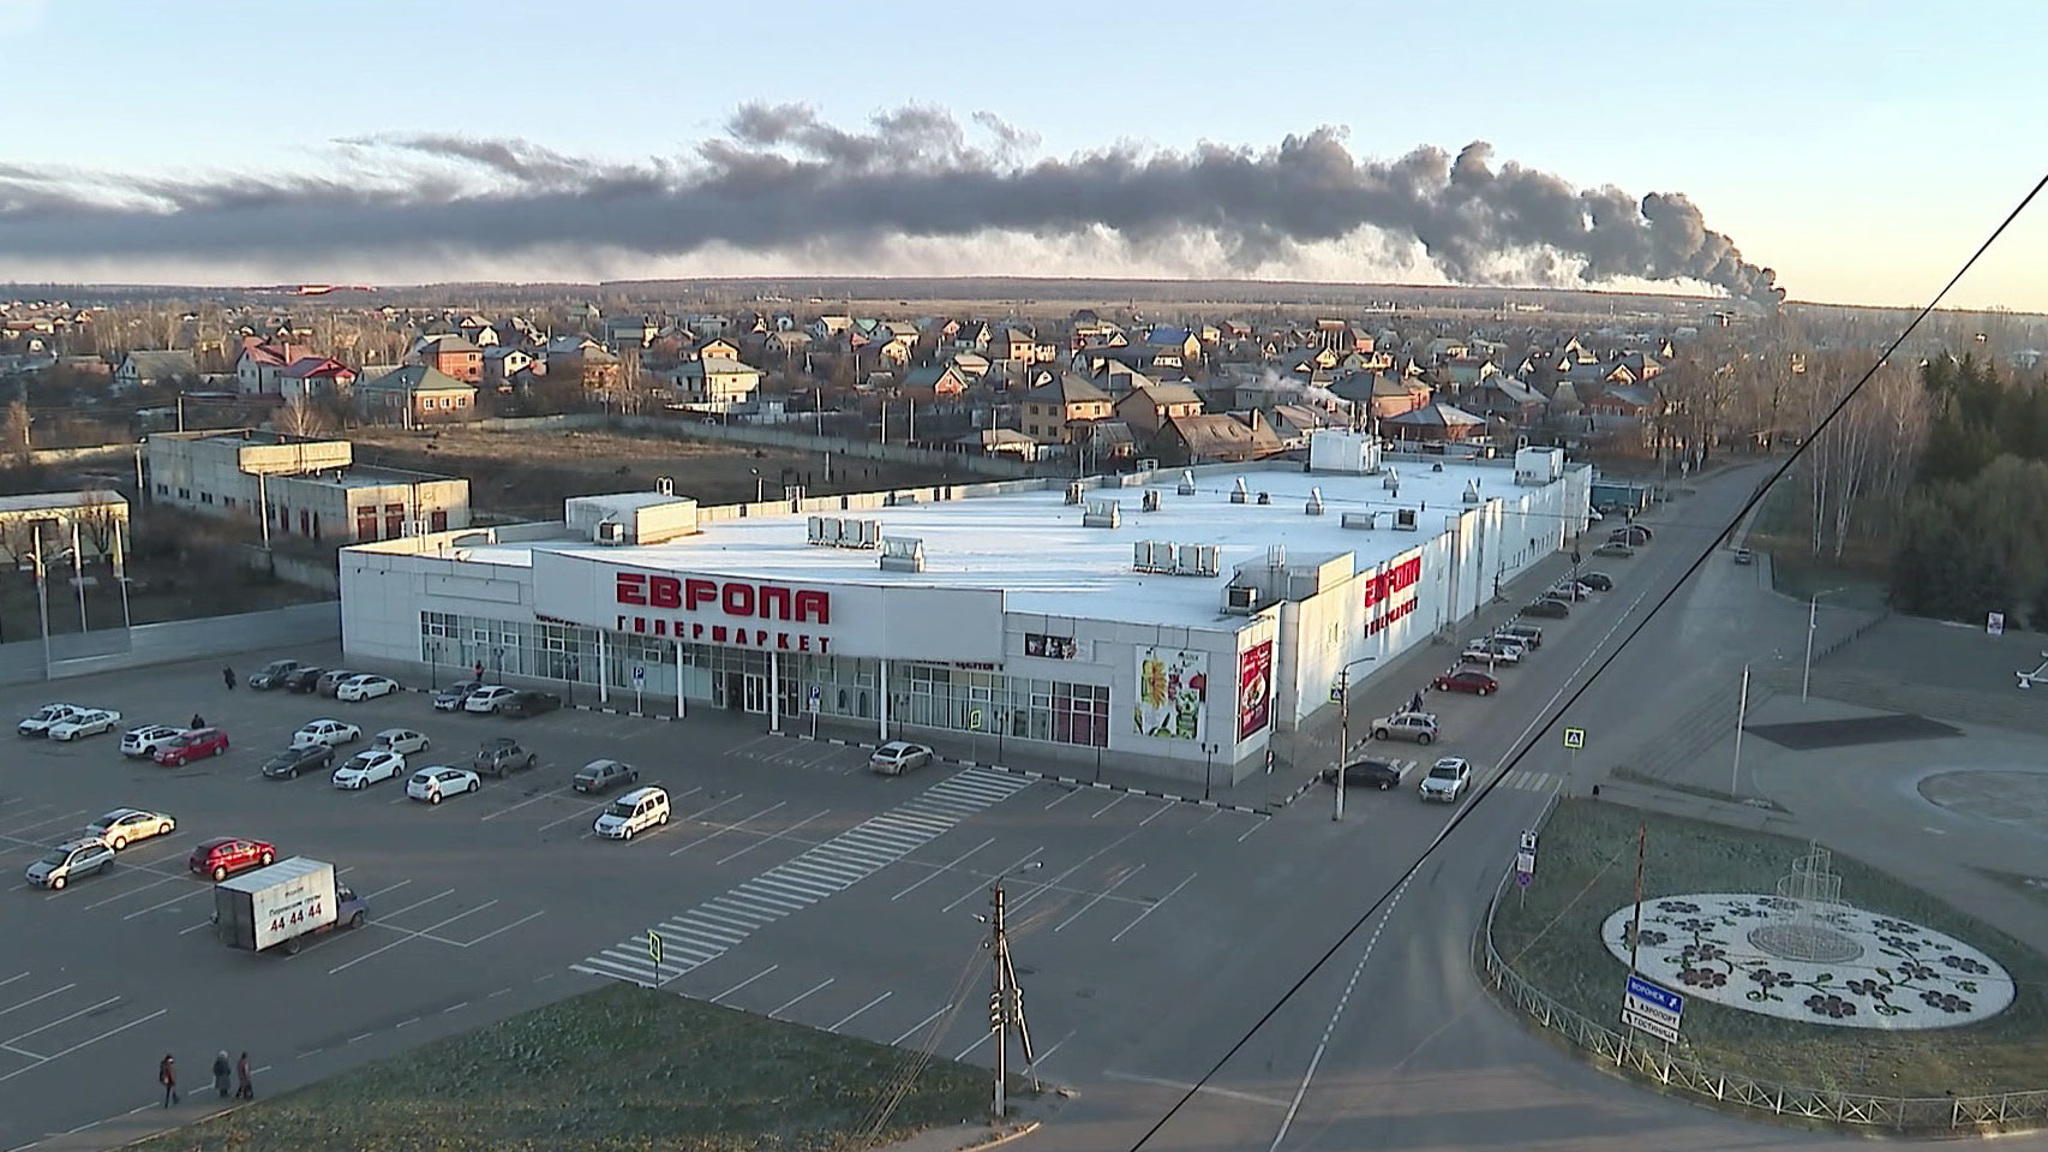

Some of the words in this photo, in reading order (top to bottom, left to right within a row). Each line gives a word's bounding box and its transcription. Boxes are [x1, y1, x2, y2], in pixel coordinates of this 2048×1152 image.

[616, 571, 830, 625] ЕВРОПА
[617, 615, 831, 654] ГИПЕРМАРКЕТ
[270, 917, 285, 932] 44
[290, 909, 304, 925] 44
[308, 902, 322, 917] 44
[1631, 981, 1665, 1002] ВОРОНЕЖ
[1640, 1003, 1677, 1024] АЭРОПОРТ
[1633, 1016, 1676, 1040] ГОСТИНИЦА
